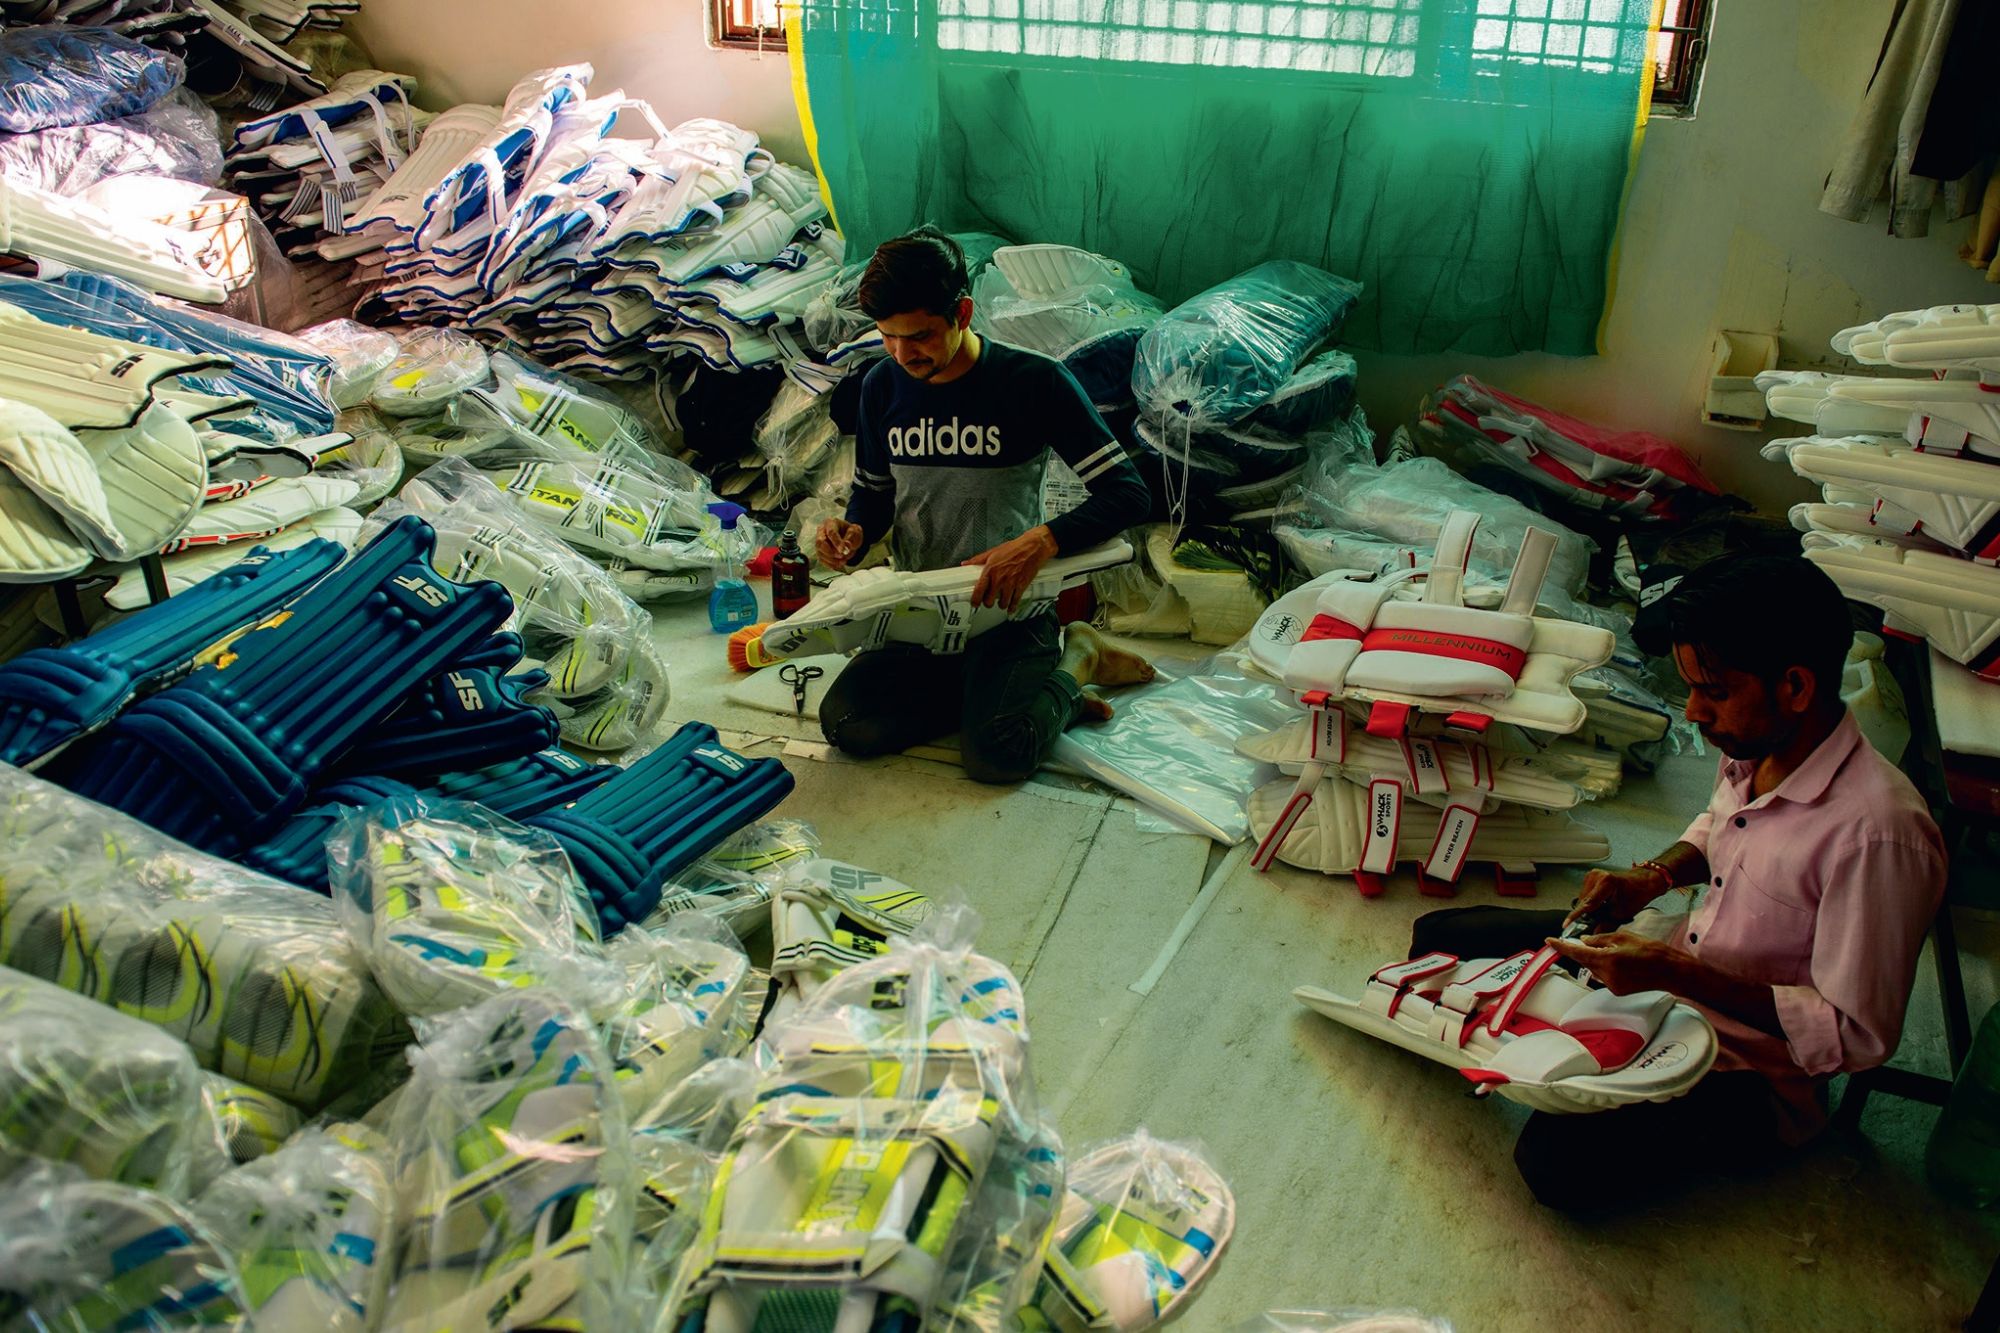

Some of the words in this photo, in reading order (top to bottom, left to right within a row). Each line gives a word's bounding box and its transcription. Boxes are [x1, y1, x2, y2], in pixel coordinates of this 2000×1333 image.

[888, 416, 1001, 456] adidas
[393, 575, 449, 608] SF
[1270, 615, 1292, 641] WHACK
[1391, 631, 1512, 662] MILLENNIUM
[448, 671, 485, 712] SF
[694, 747, 746, 772] SF
[1376, 793, 1387, 826] WHACK
[1443, 842, 1456, 864] NEVER
[1452, 819, 1465, 843] BEATEN
[830, 865, 882, 890] SF
